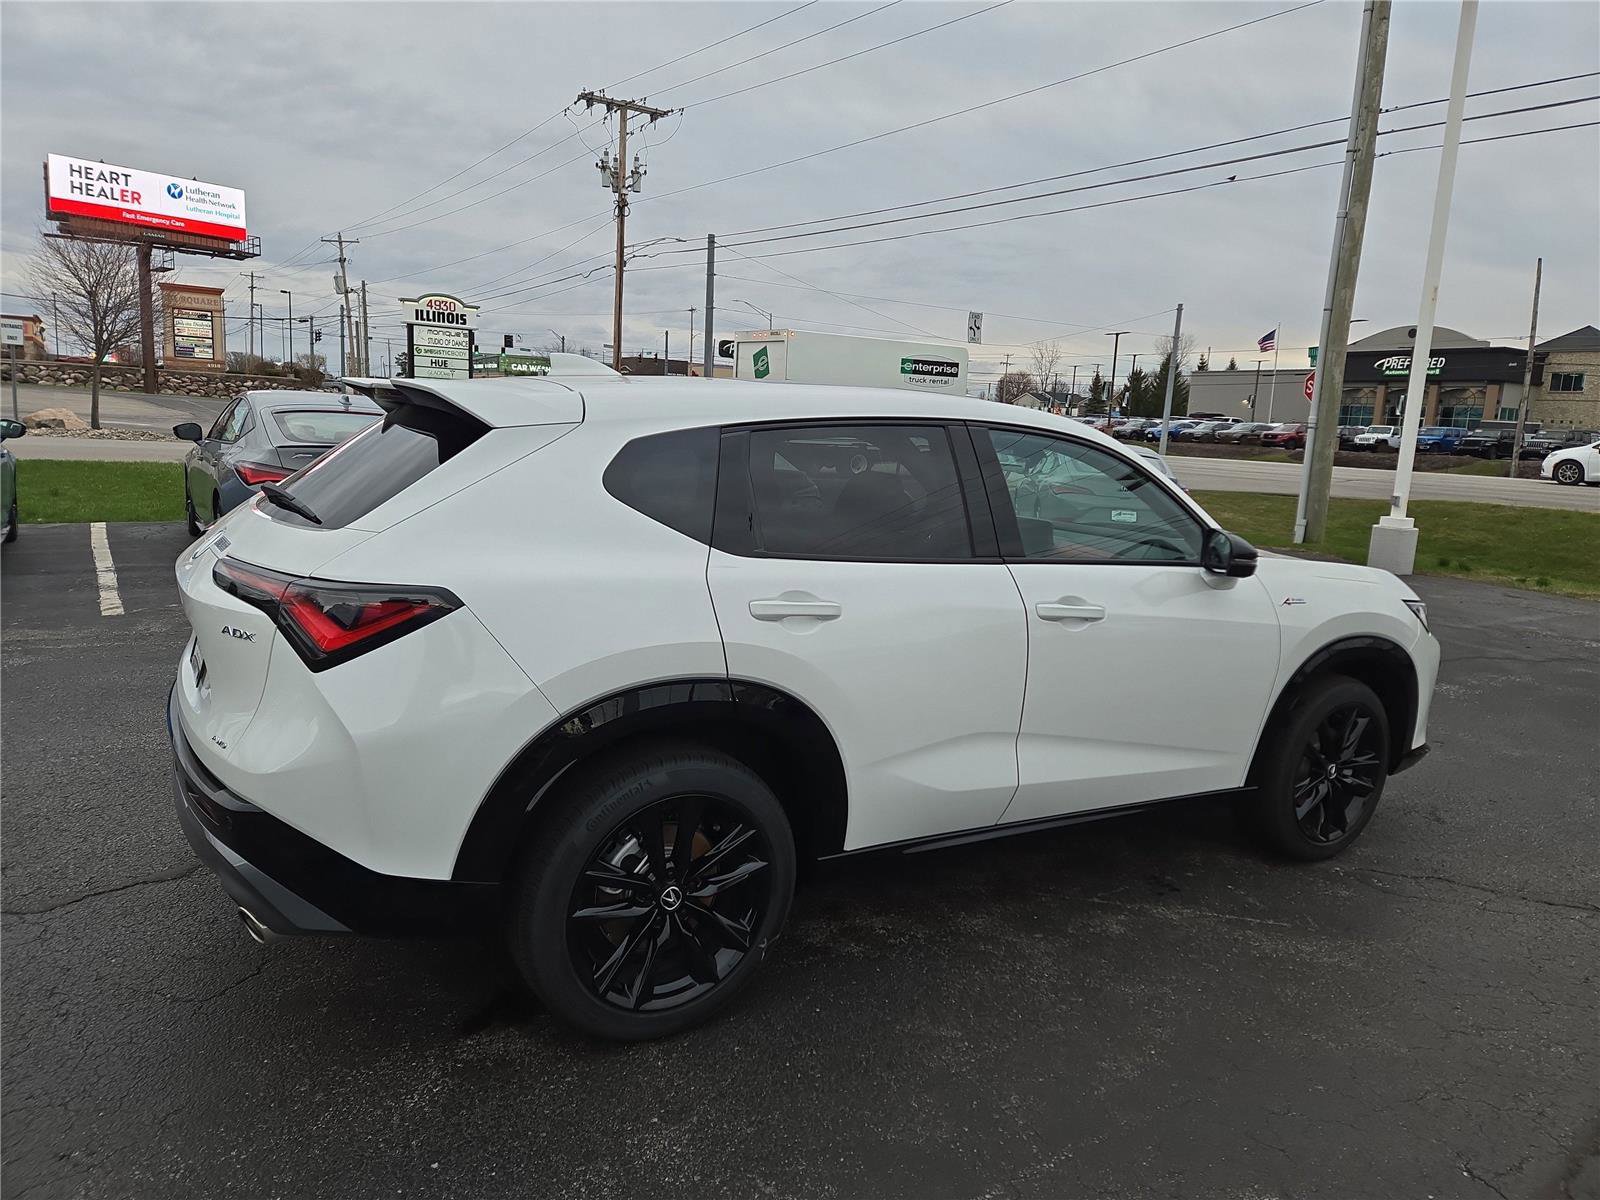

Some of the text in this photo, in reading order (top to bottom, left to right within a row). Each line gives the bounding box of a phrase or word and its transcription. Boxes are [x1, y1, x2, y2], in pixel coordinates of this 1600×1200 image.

[69, 163, 132, 187] HEART
[70, 180, 142, 205] HEALER
[185, 185, 221, 199] Lutheran
[185, 195, 236, 210] Health Network
[122, 211, 185, 227] Fast Emergency Care
[186, 205, 241, 220] Lutheran Hospital
[426, 299, 456, 312] 4930
[415, 308, 467, 326] ILLINOIS
[427, 337, 469, 348] STUDIO OF DANCE
[430, 358, 449, 368] HUE
[511, 363, 528, 371] CAR
[902, 361, 958, 375] enterprise
[908, 376, 950, 385] truck rental
[221, 625, 256, 643] ADX
